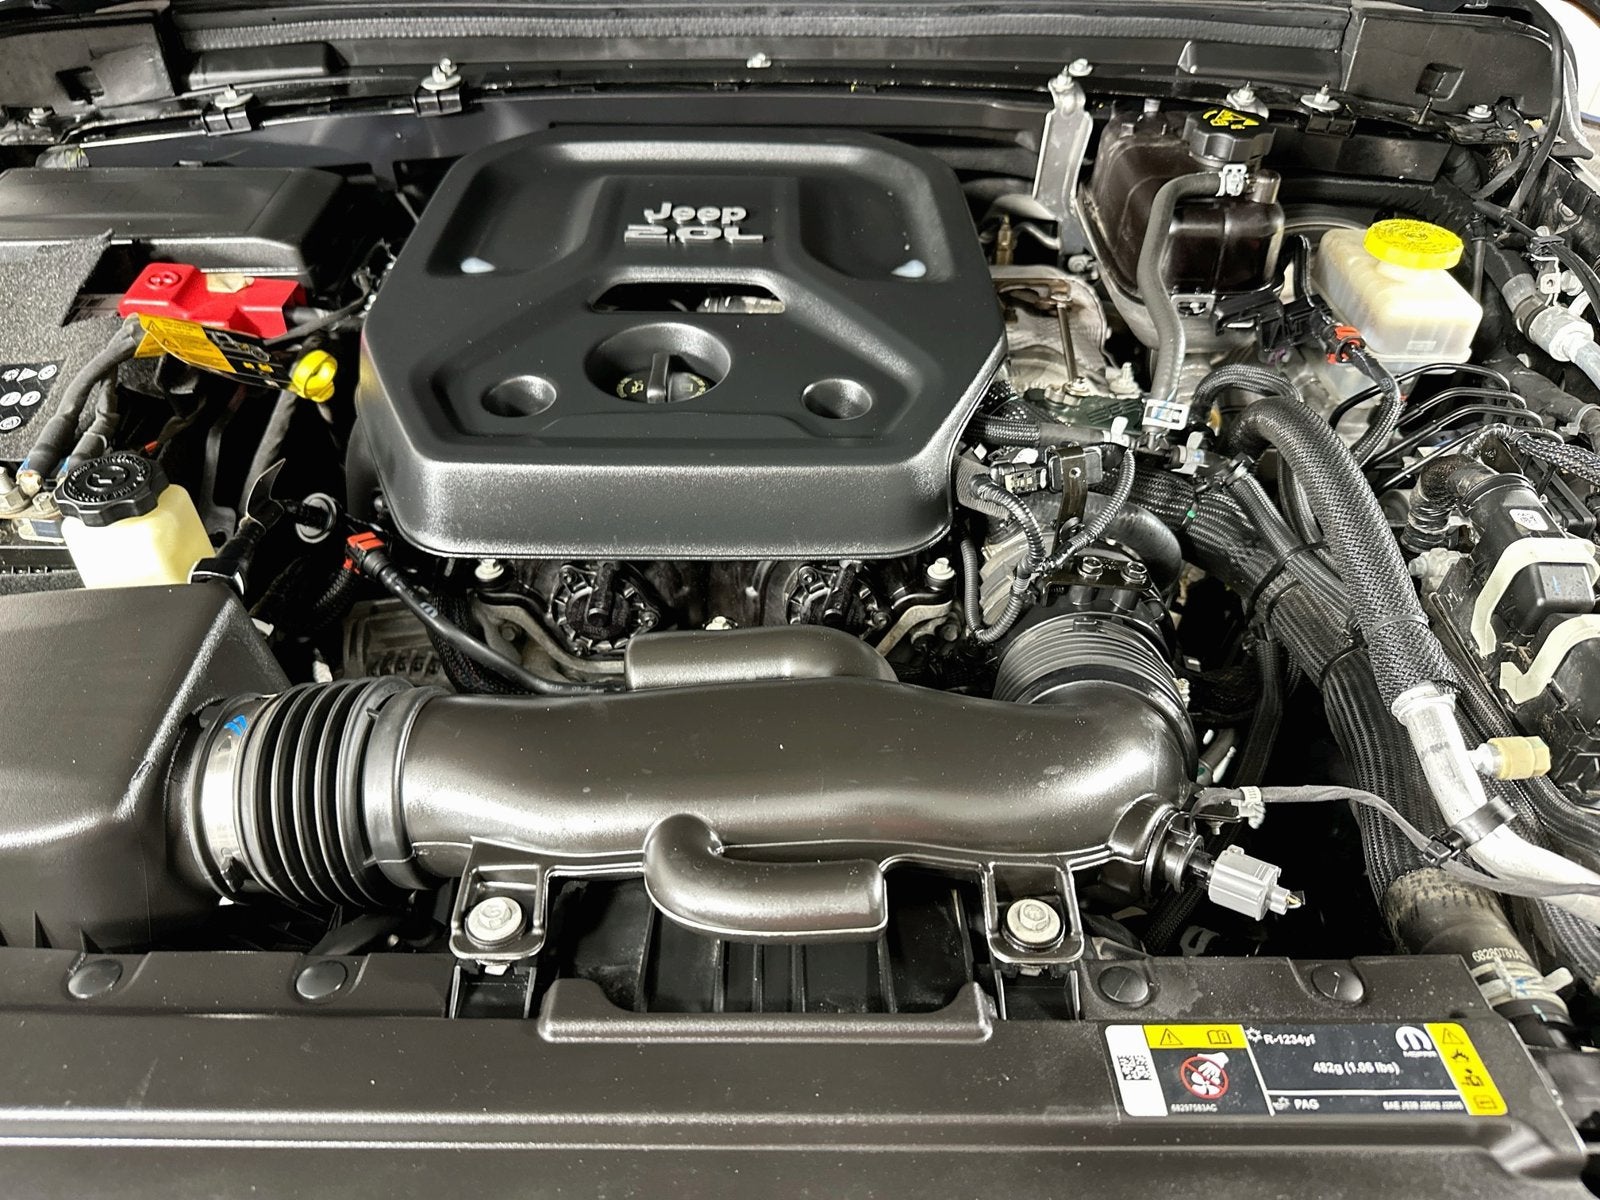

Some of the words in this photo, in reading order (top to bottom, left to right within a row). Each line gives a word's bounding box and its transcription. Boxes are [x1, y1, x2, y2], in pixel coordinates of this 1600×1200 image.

[643, 202, 747, 225] Jeep
[624, 224, 764, 243] 2.0L
[1263, 1033, 1316, 1047] R-1234yf
[1313, 1062, 1344, 1076] 482g
[1374, 1061, 1401, 1075] lbs)
[1294, 1099, 1320, 1110] PAG
